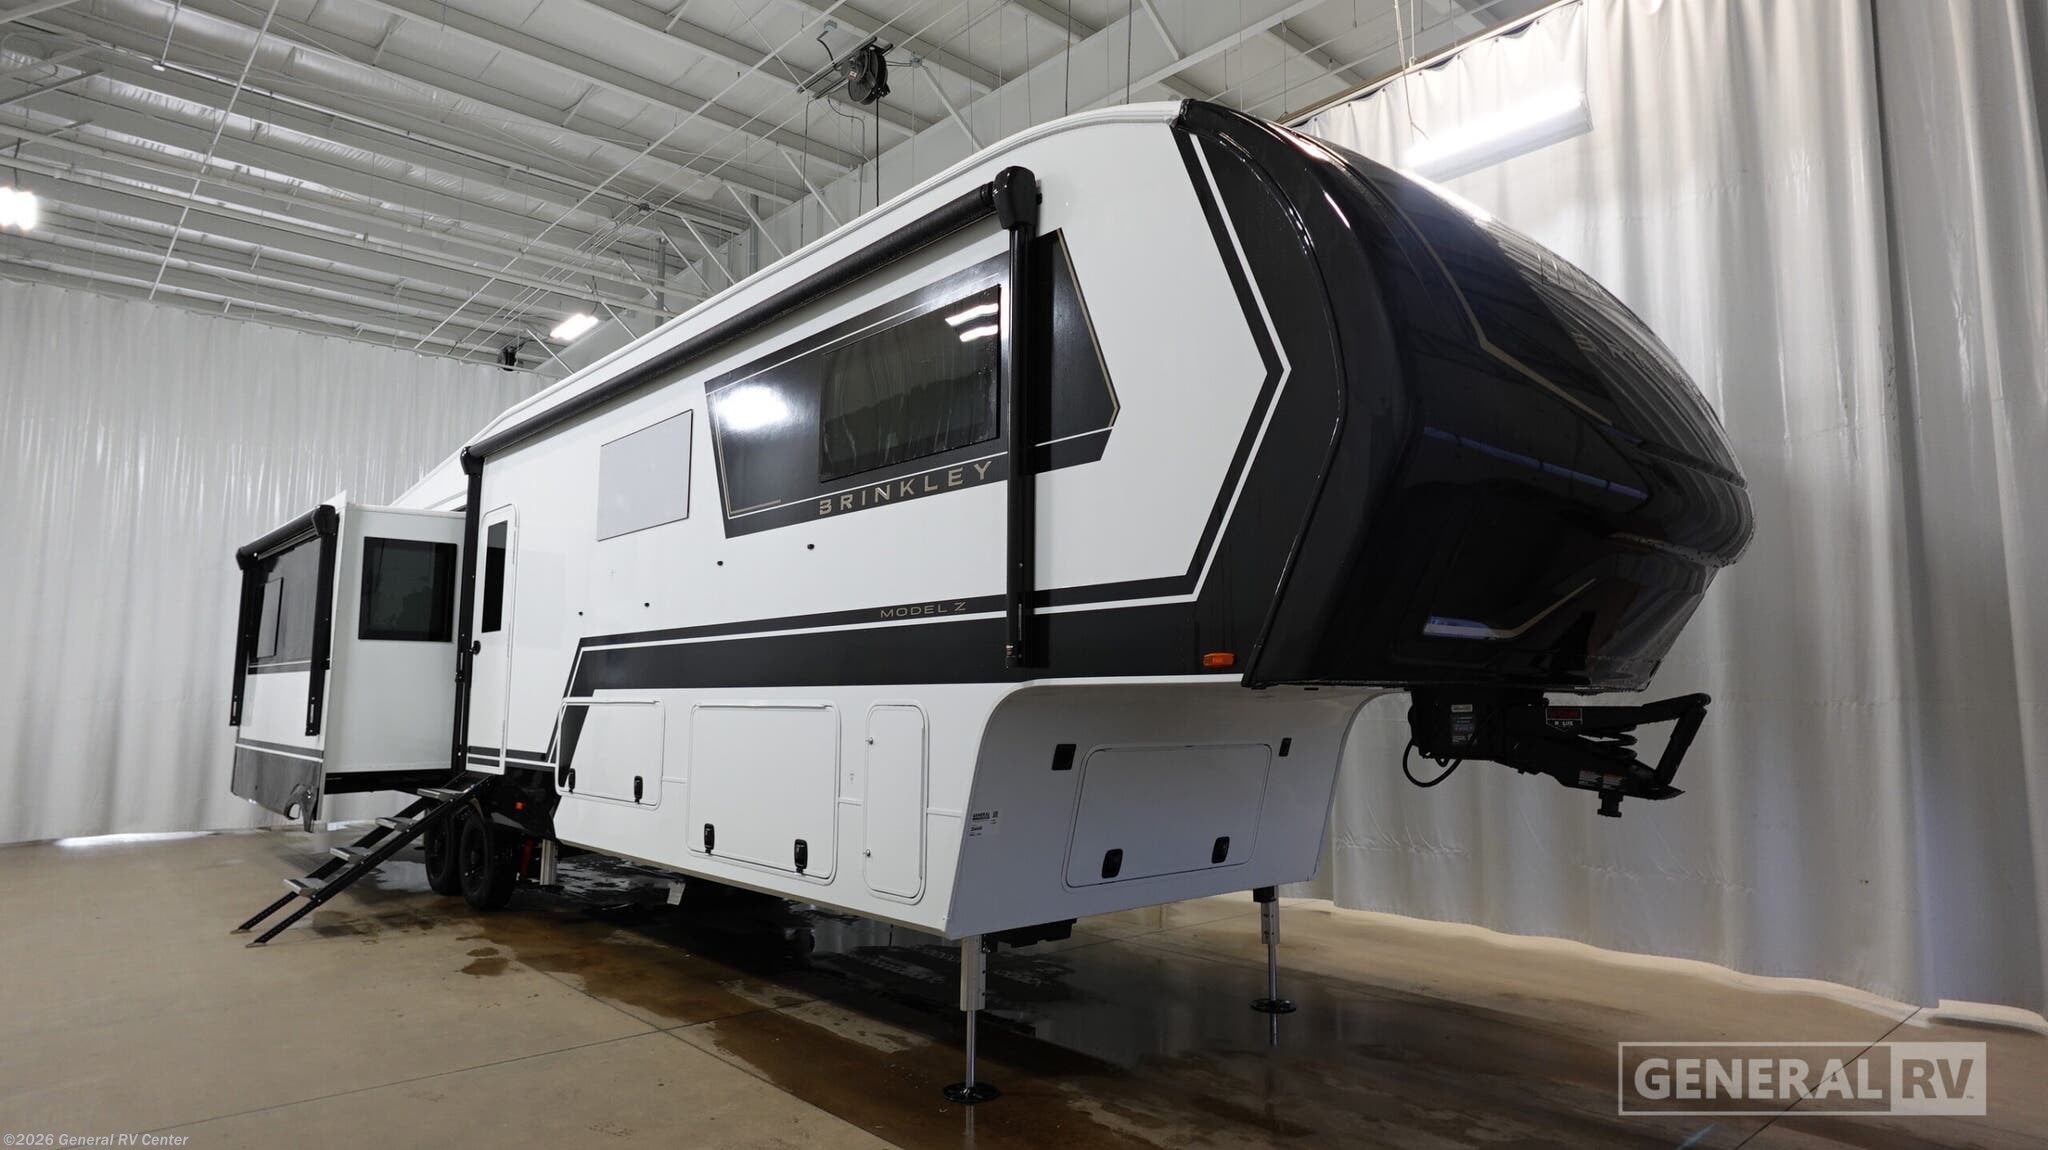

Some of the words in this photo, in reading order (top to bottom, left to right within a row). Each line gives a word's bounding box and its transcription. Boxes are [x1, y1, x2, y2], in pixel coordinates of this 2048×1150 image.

[819, 460, 992, 515] BRINKLEY
[880, 603, 948, 619] MODEL
[954, 601, 967, 612] Z
